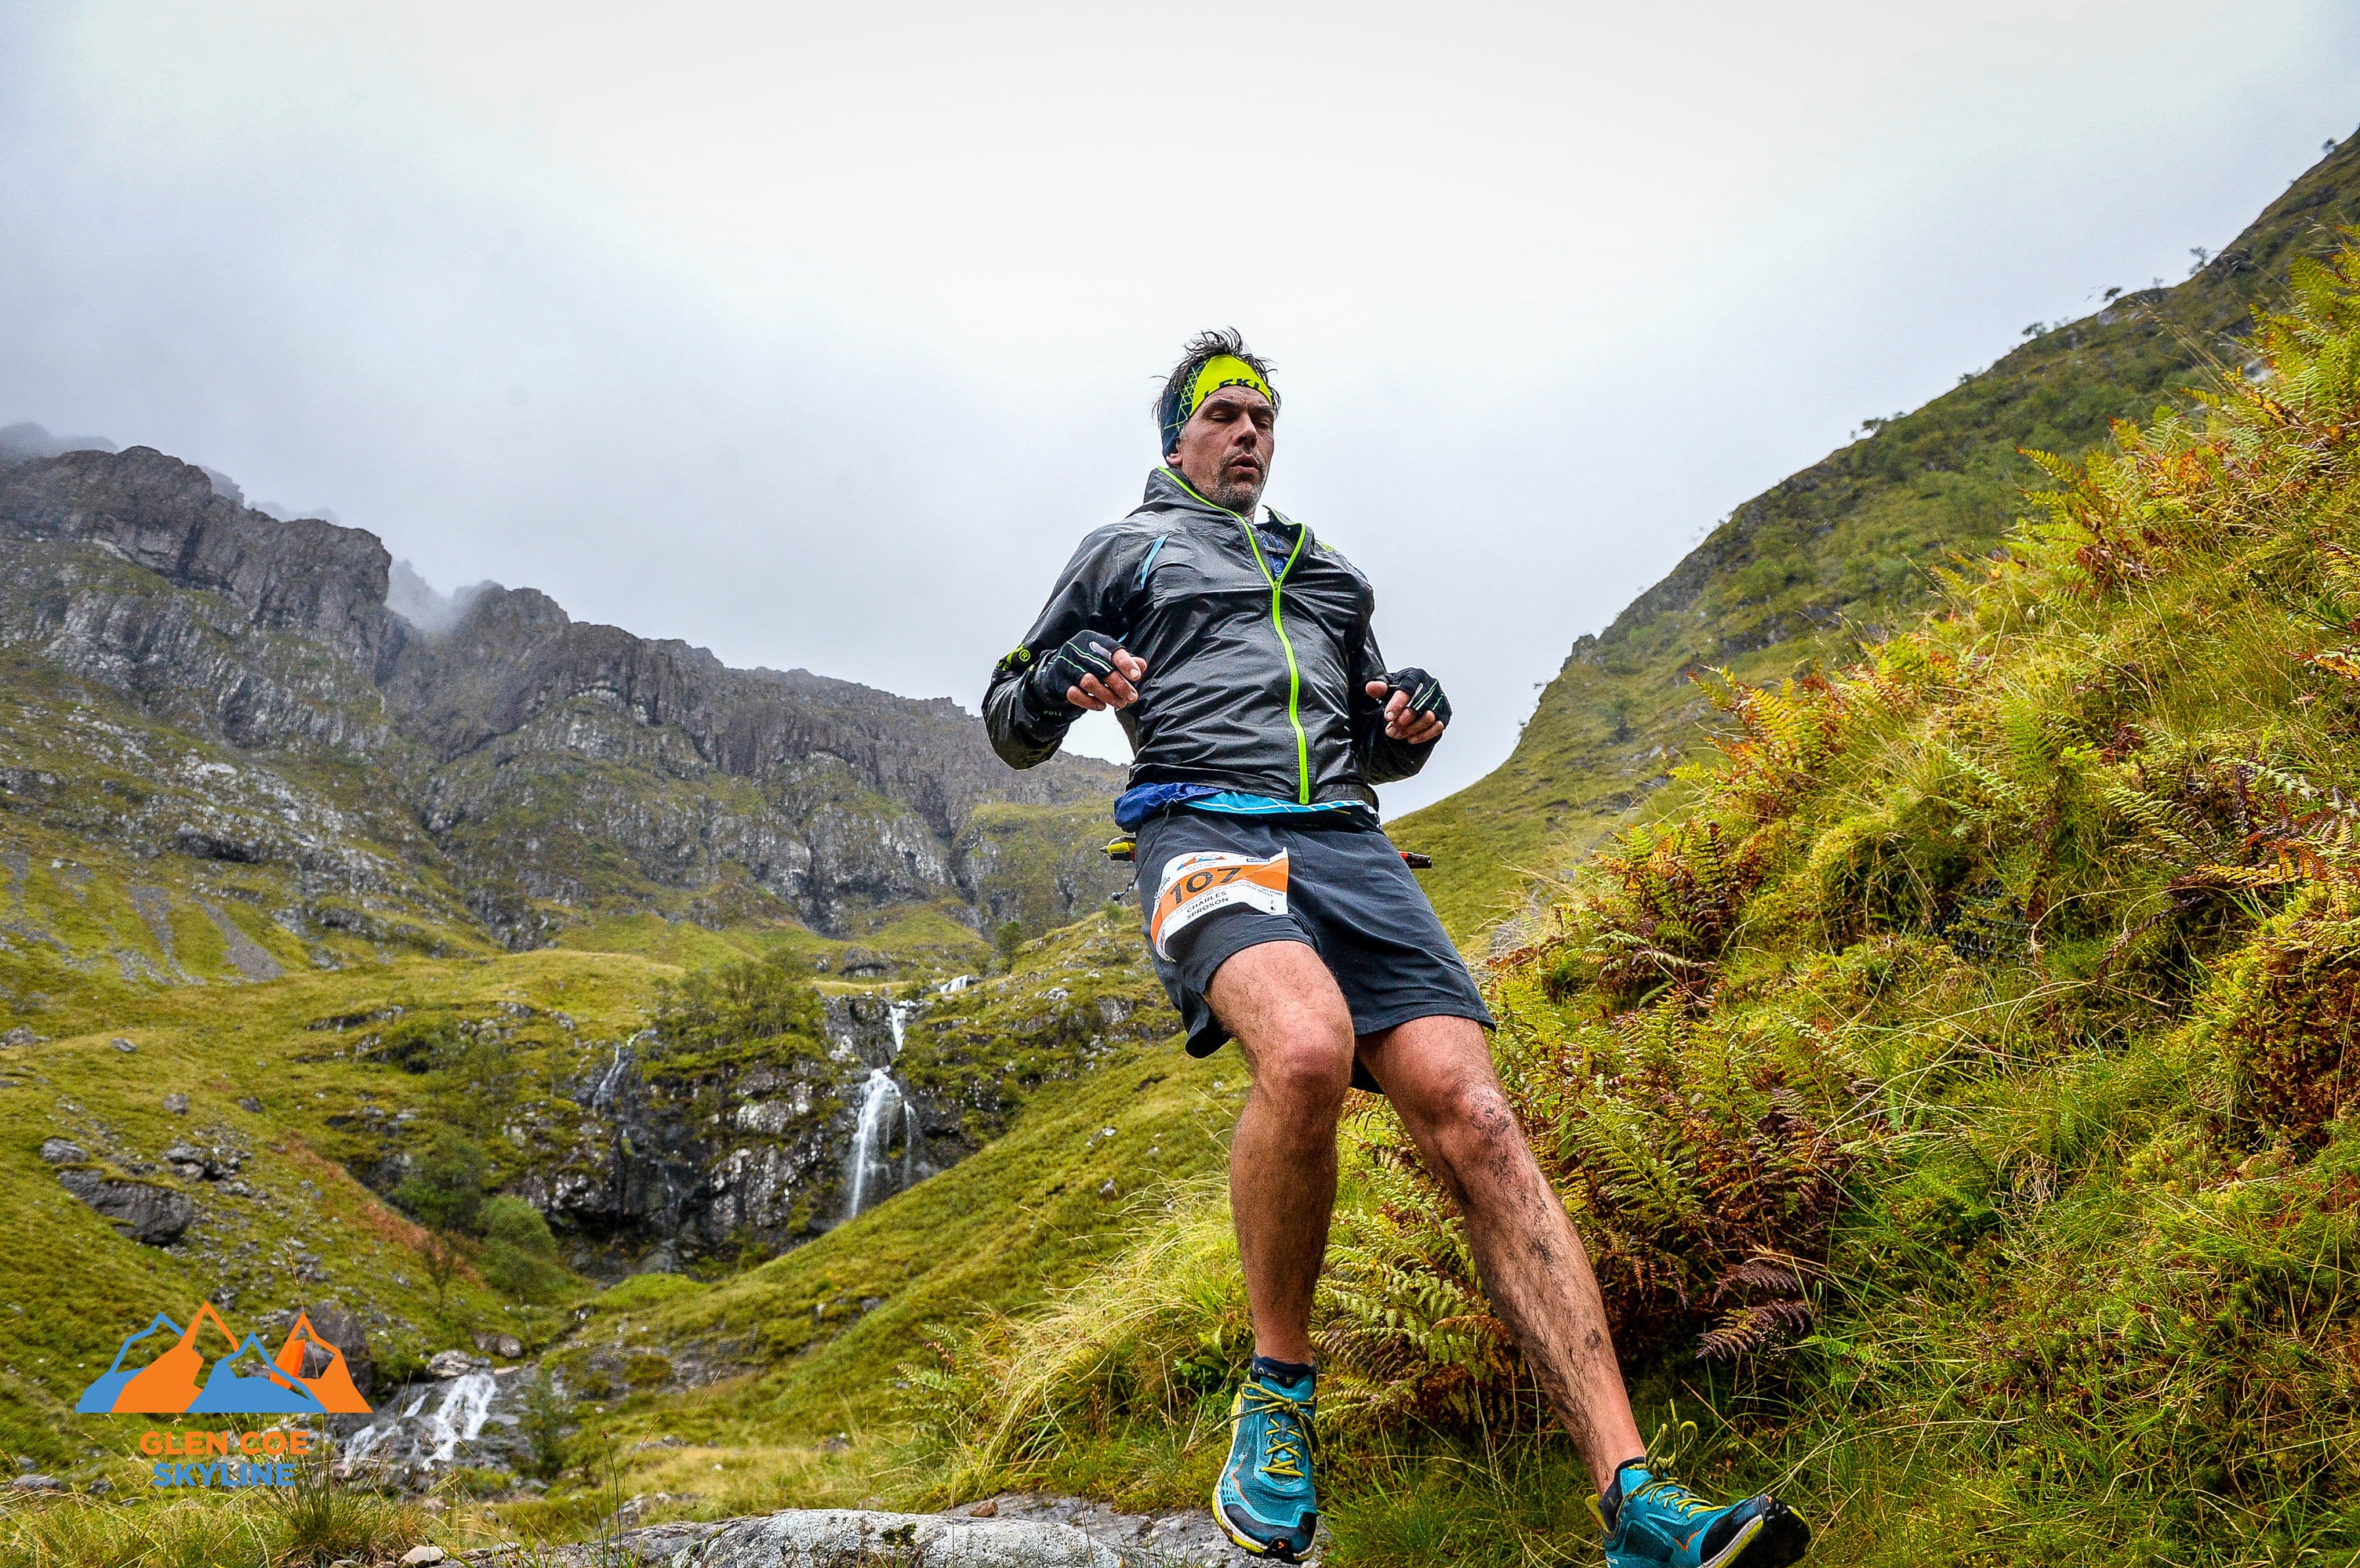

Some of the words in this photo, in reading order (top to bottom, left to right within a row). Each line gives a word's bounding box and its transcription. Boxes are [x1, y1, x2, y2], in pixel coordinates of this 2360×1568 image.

[1171, 867, 1242, 905] 107
[1187, 891, 1227, 913] CHARLES
[1187, 897, 1229, 920] SPROSON
